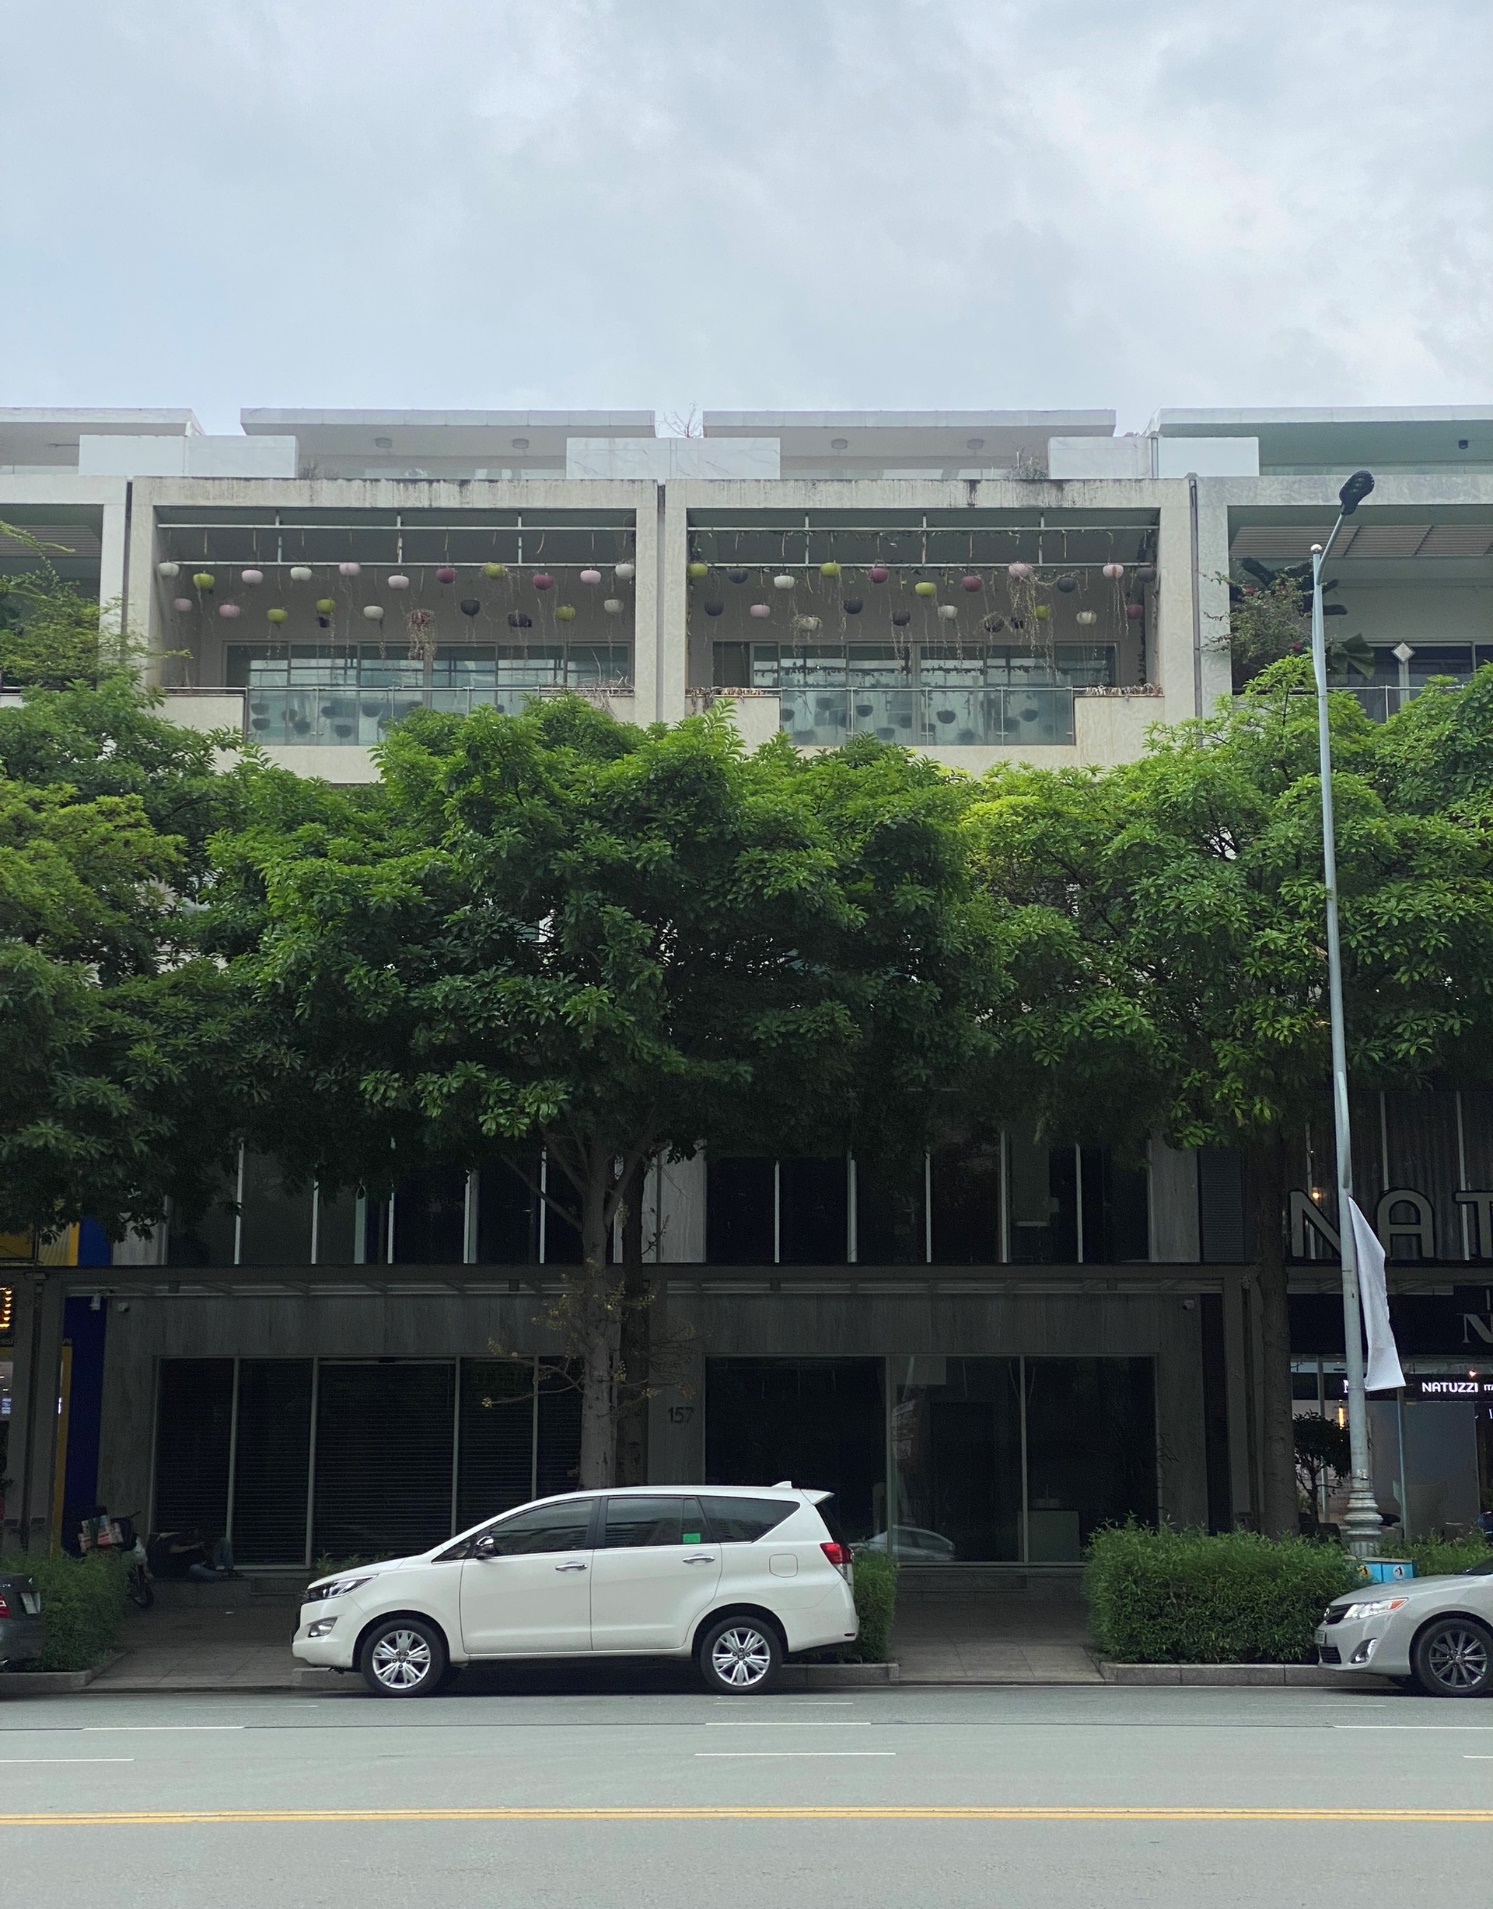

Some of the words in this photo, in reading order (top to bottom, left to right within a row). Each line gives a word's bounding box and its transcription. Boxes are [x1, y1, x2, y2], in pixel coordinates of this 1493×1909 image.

[1289, 1188, 1493, 1259] NAT
[1421, 1381, 1479, 1393] NATUZZI
[667, 1406, 694, 1424] 157
